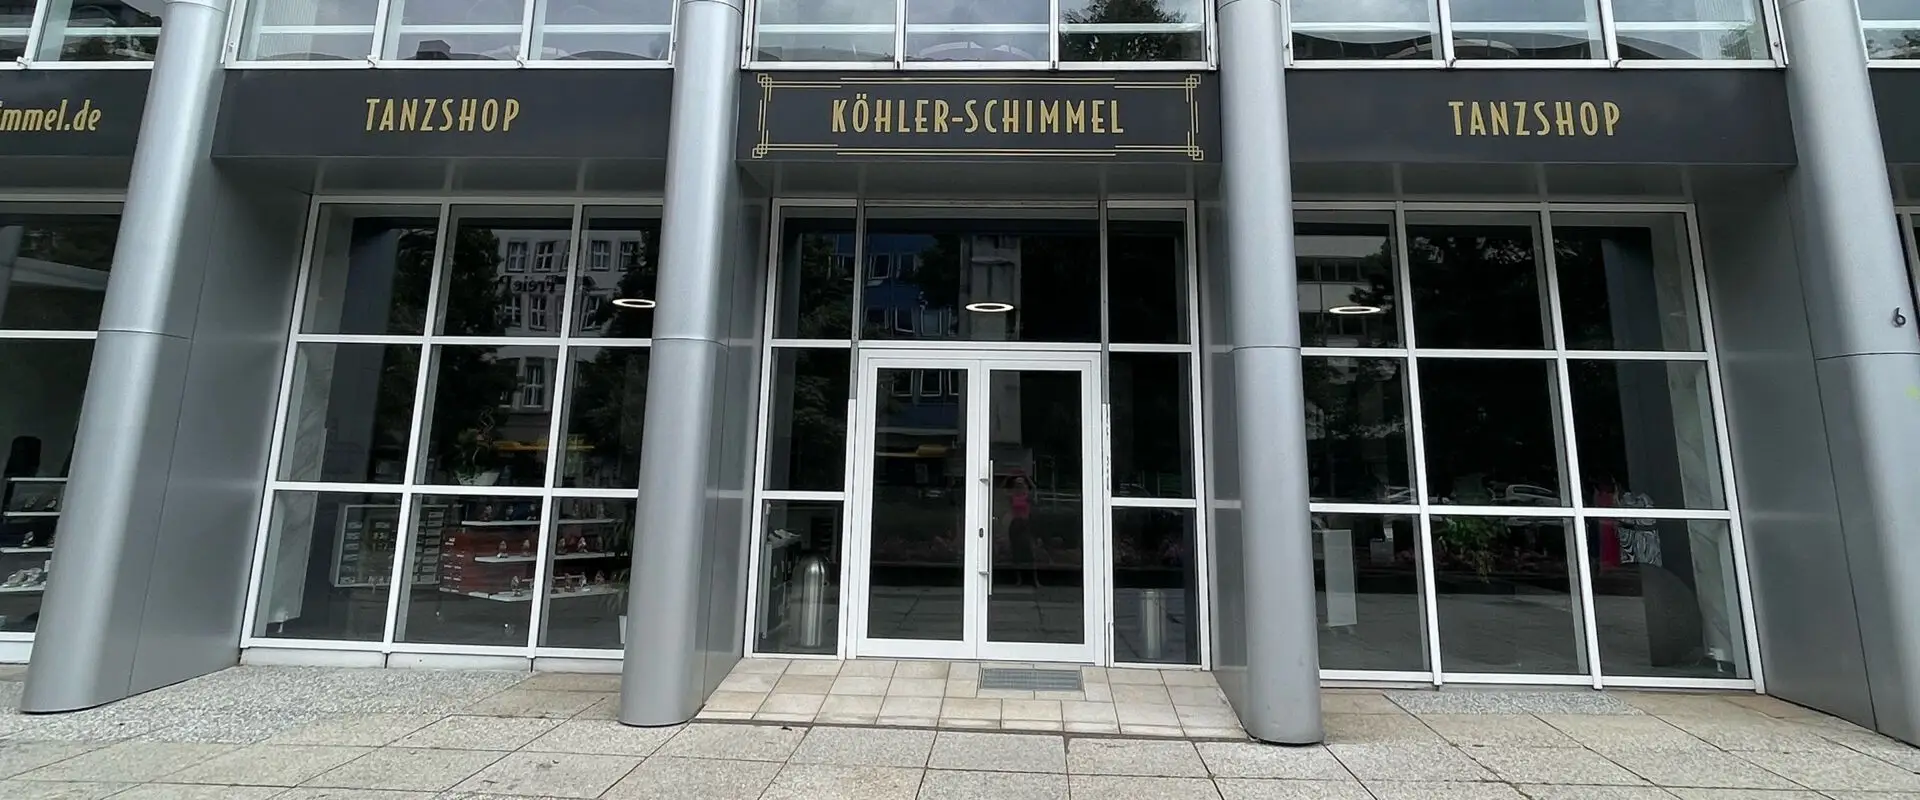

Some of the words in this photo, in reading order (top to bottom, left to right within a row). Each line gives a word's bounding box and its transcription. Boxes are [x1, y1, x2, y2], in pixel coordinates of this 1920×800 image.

[0, 99, 102, 131] mmel.de
[365, 98, 520, 132] TANZSHOP
[831, 93, 1124, 133] KÖHLER-SCHIMMEL
[1448, 101, 1620, 136] TANZSHOP
[1893, 306, 1906, 328] 6
